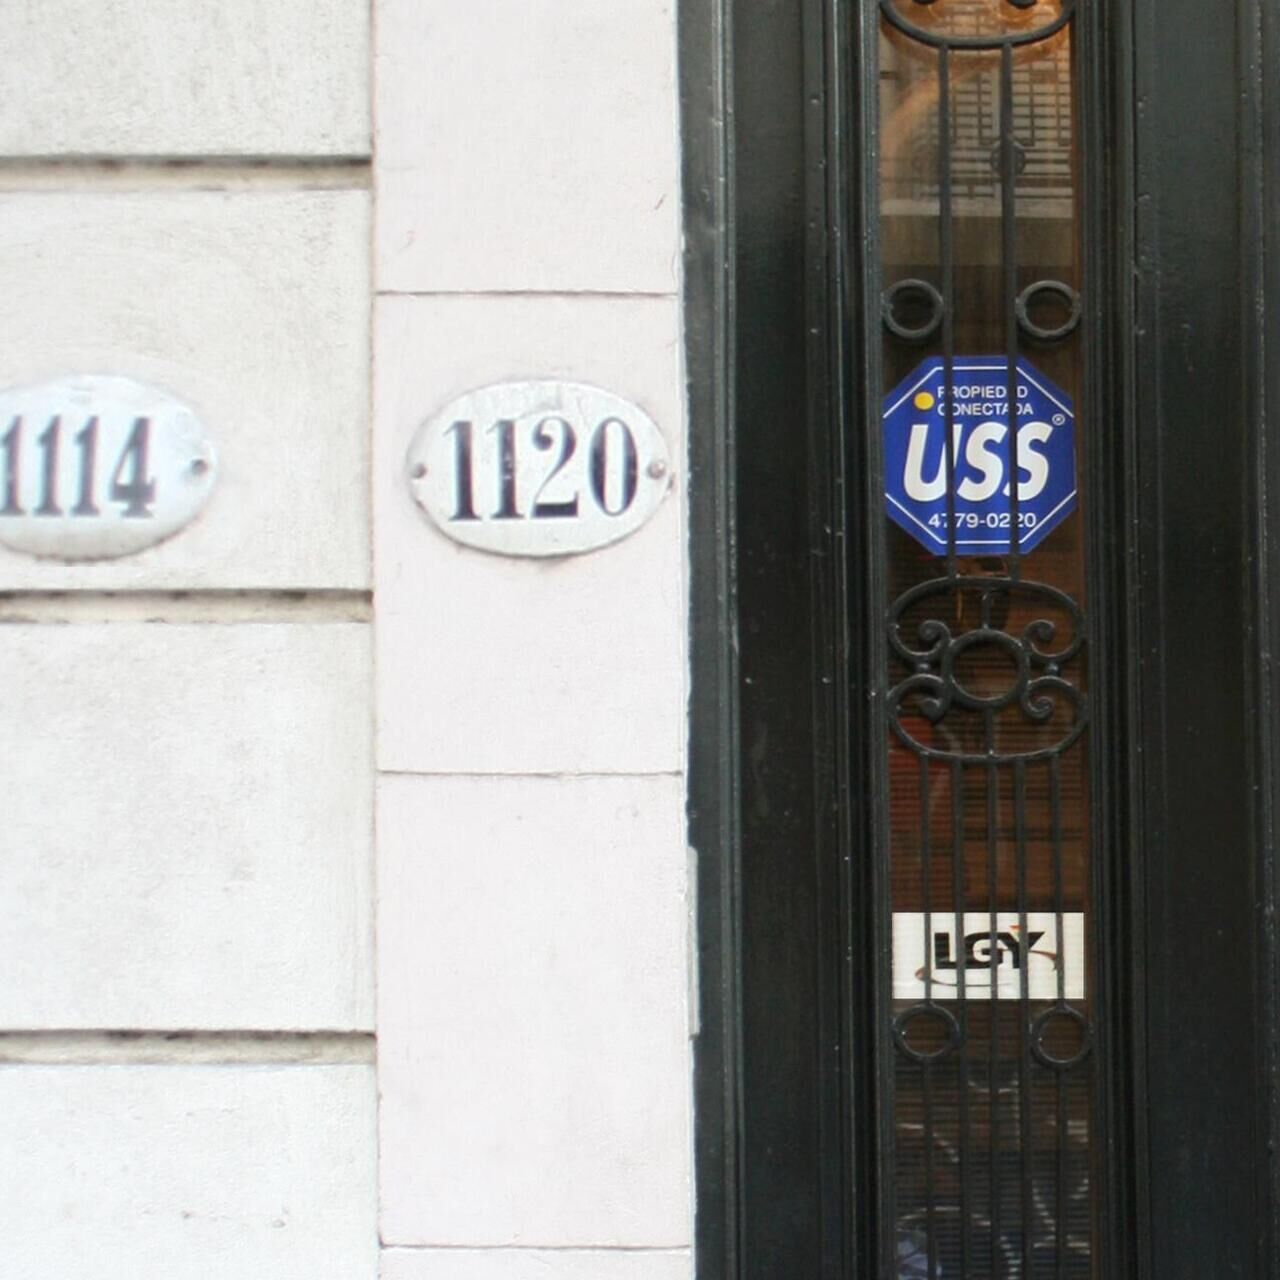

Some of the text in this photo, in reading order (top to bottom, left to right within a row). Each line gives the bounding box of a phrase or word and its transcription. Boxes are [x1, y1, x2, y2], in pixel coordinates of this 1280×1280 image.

[937, 385, 1028, 399] PROPIEDD
[0, 414, 157, 518] 1114
[443, 416, 638, 521] 1120
[903, 421, 1053, 502] USS
[934, 931, 1046, 970] LGY
